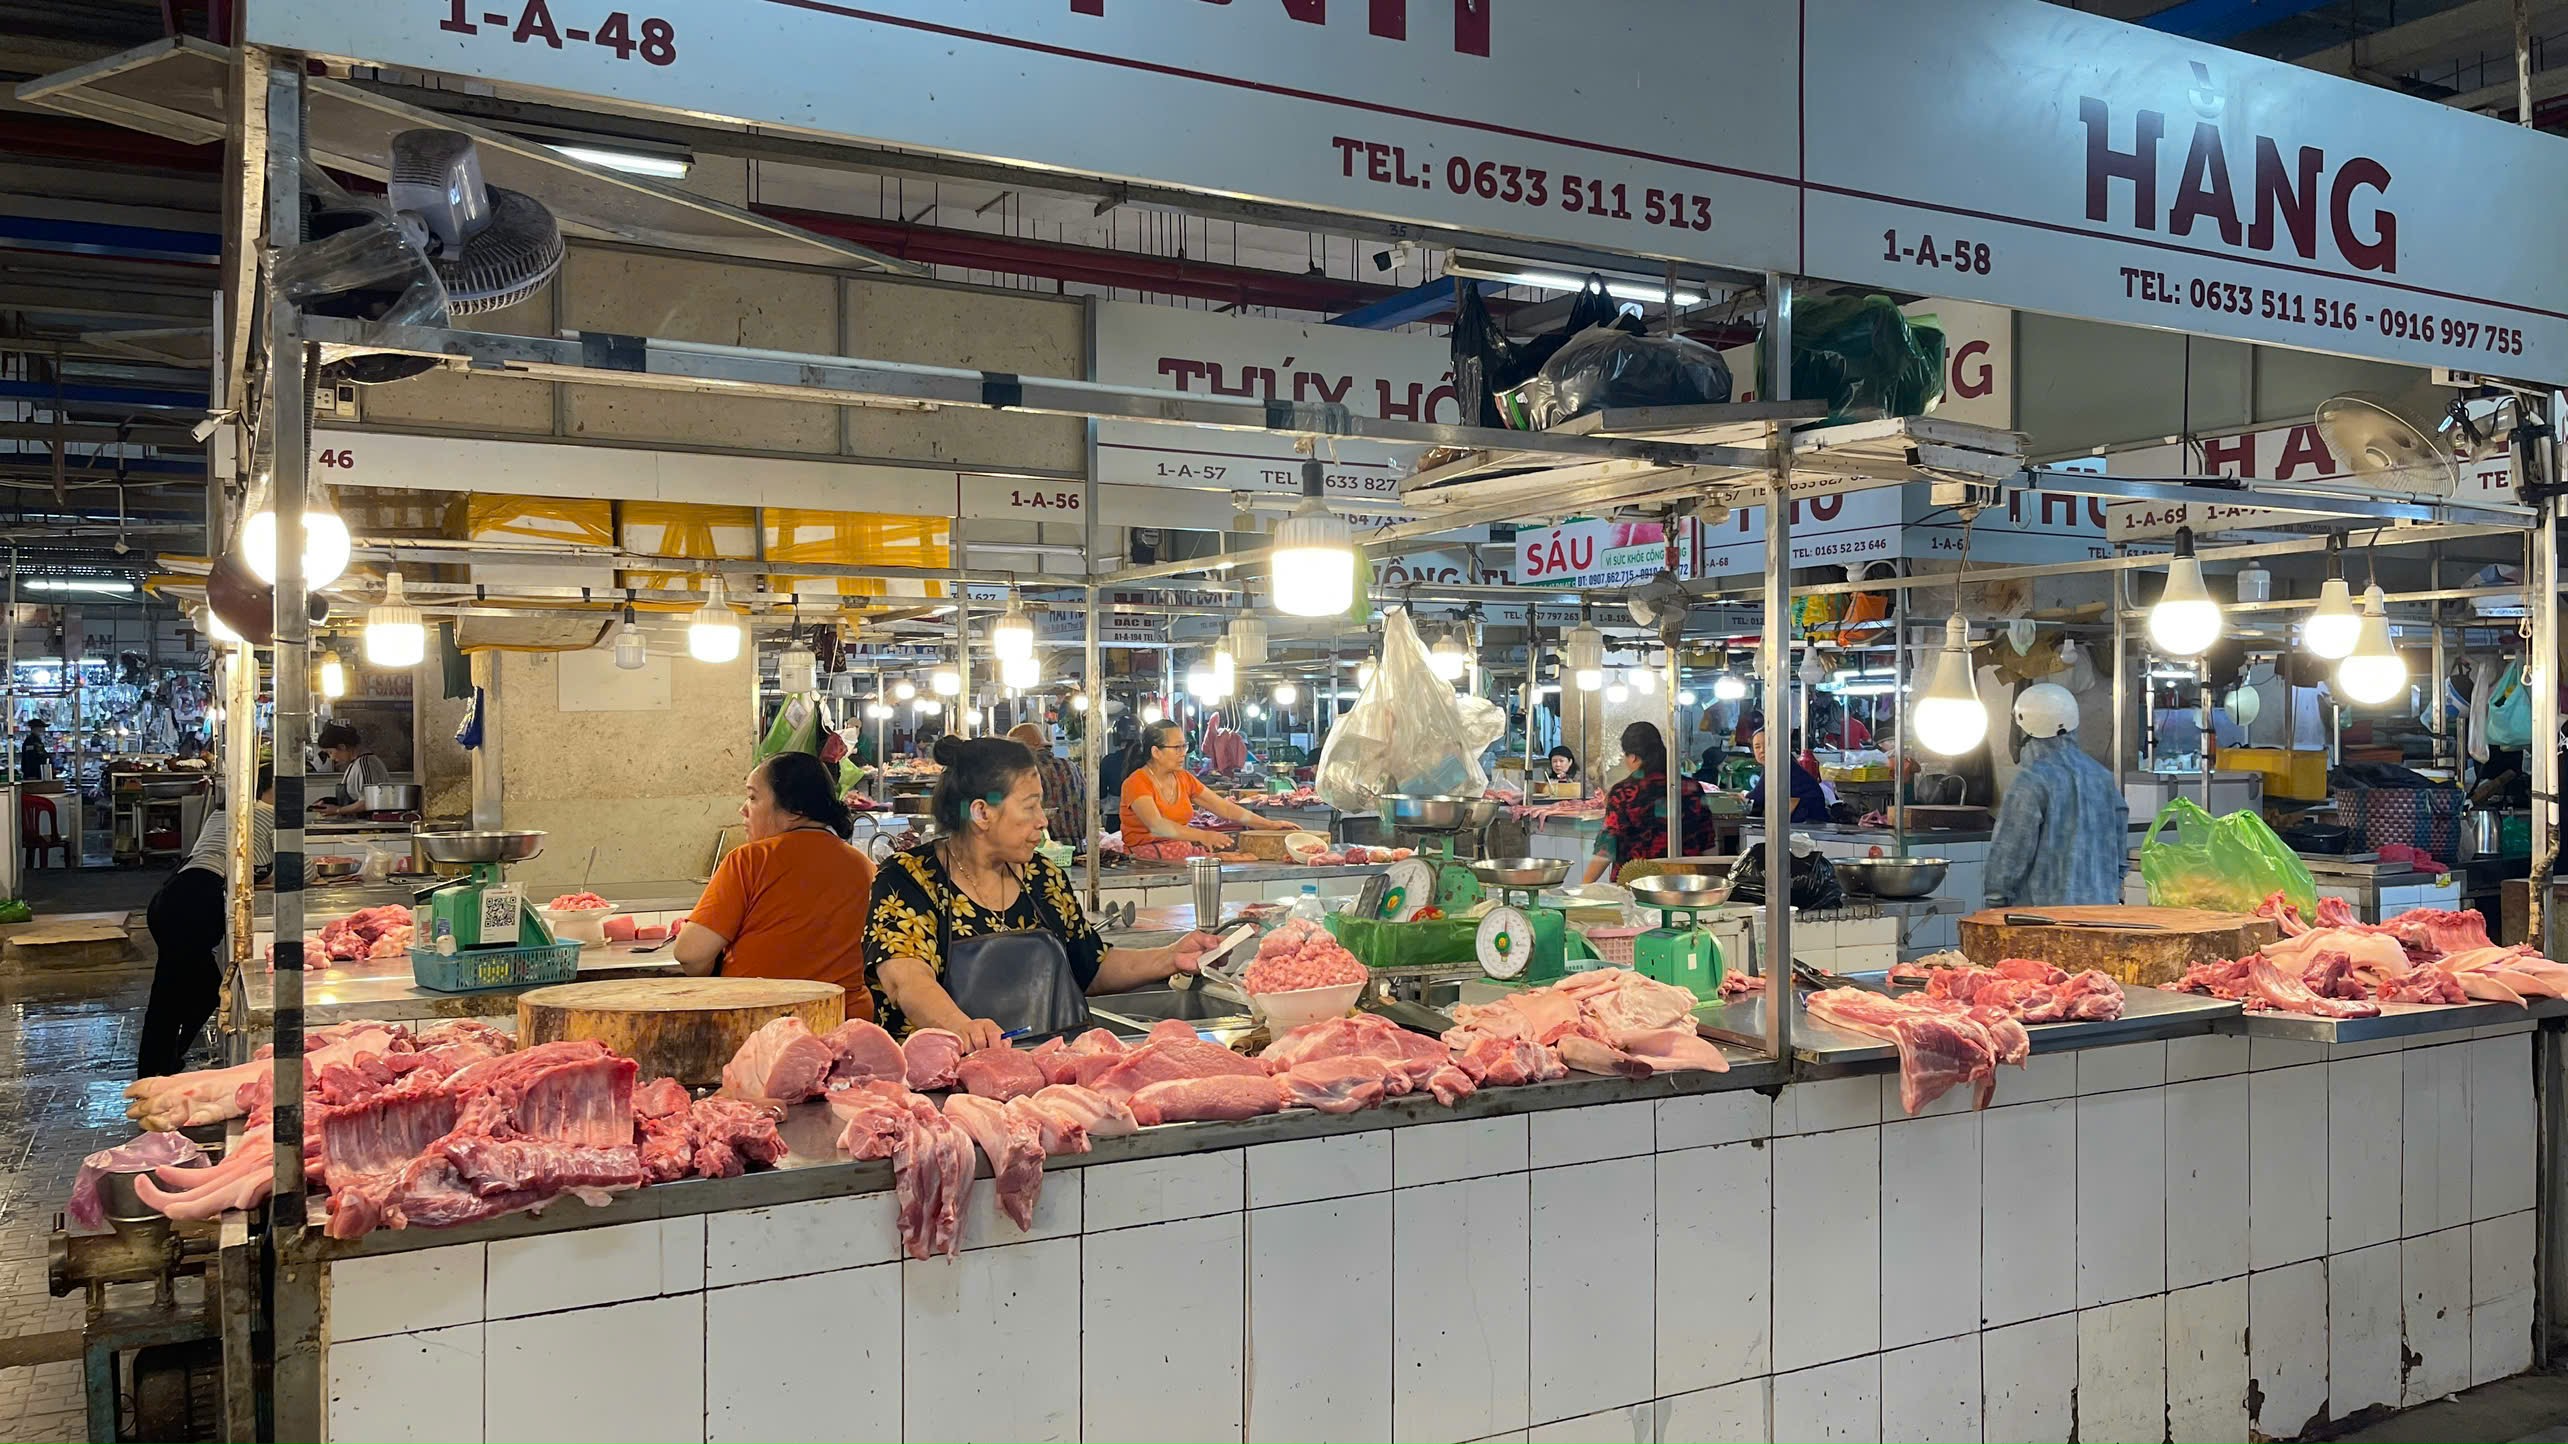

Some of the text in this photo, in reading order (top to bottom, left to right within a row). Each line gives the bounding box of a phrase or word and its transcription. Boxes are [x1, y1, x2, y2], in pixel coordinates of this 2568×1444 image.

[440, 0, 677, 66] 1-A-48
[1332, 136, 1712, 232] TEL: 0633 511 513
[2079, 60, 2397, 274] HẰNG
[1883, 229, 1992, 275] 1-A-58
[2120, 267, 2181, 305] TEL:
[2190, 278, 2253, 315] 0633
[2261, 289, 2306, 323] 511
[2314, 298, 2357, 331] 516
[2380, 308, 2435, 342] 0916
[2441, 318, 2479, 348] 997
[2485, 325, 2523, 356] 755
[319, 449, 354, 469] 46
[1157, 462, 1227, 480] 1-A-57
[1011, 490, 1079, 509] 1-A-56
[2126, 507, 2186, 528] 1-A-69
[1527, 530, 1593, 576] SÁU
[1793, 538, 1887, 558] TEL: 0163 52 23 646
